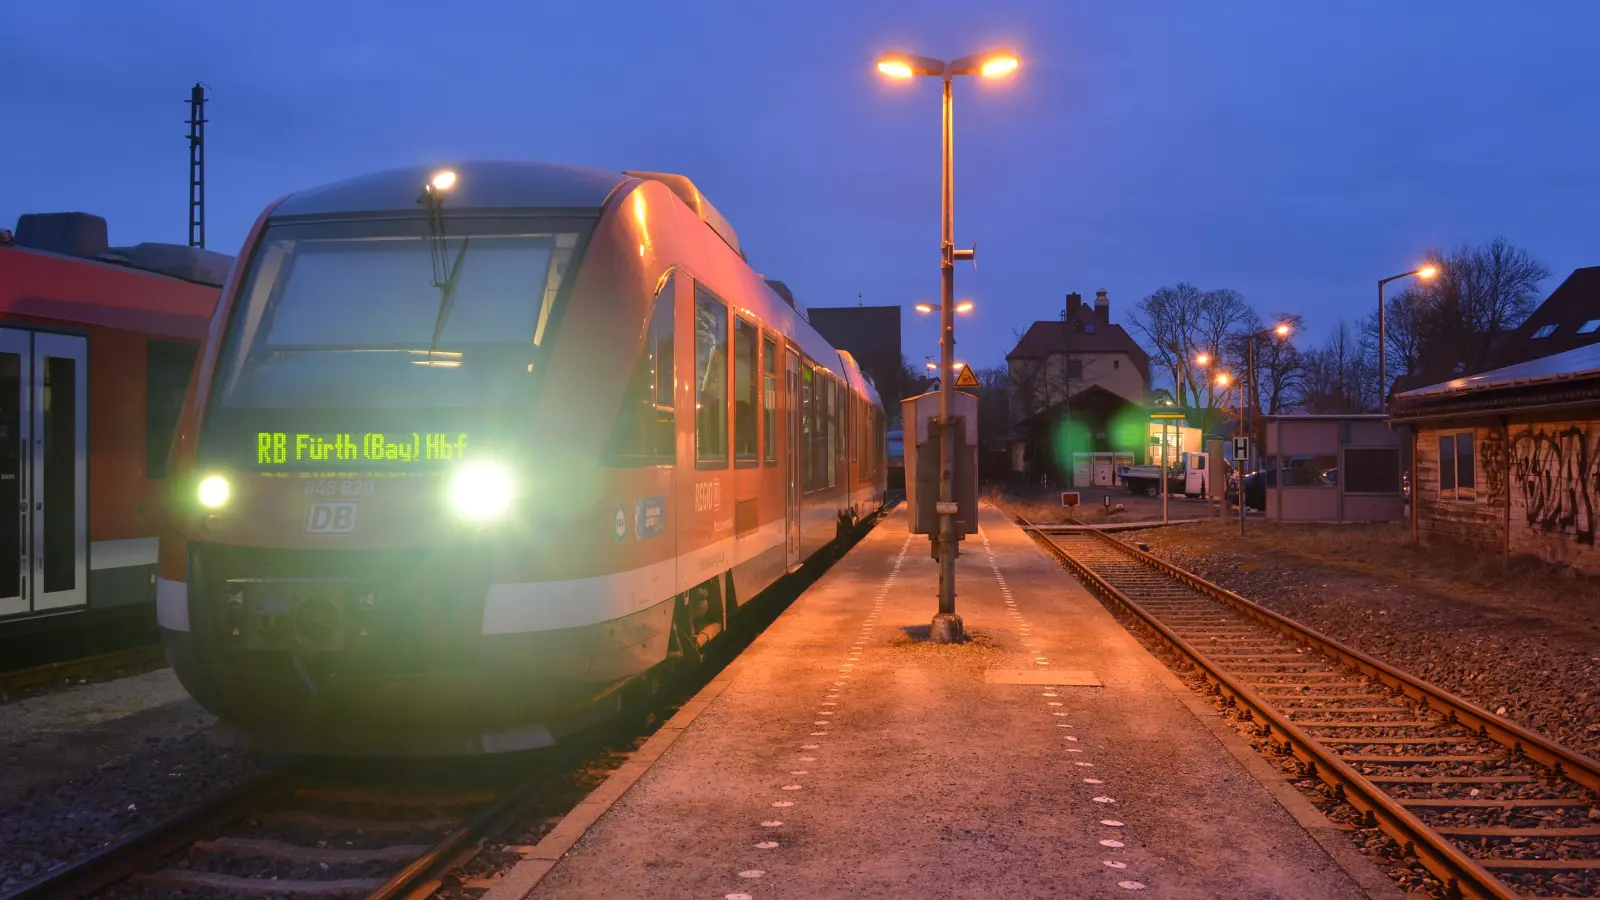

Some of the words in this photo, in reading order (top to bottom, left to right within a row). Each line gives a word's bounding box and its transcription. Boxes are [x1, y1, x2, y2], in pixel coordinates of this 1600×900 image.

[257, 432, 288, 464] RB
[296, 433, 358, 460] Fürth
[363, 432, 420, 462] (Bay)
[426, 433, 467, 460] Hbf
[1234, 438, 1248, 459] H
[304, 480, 337, 496] 648
[341, 480, 375, 496] 820
[695, 482, 713, 512] REGIO
[309, 505, 355, 531] DB
